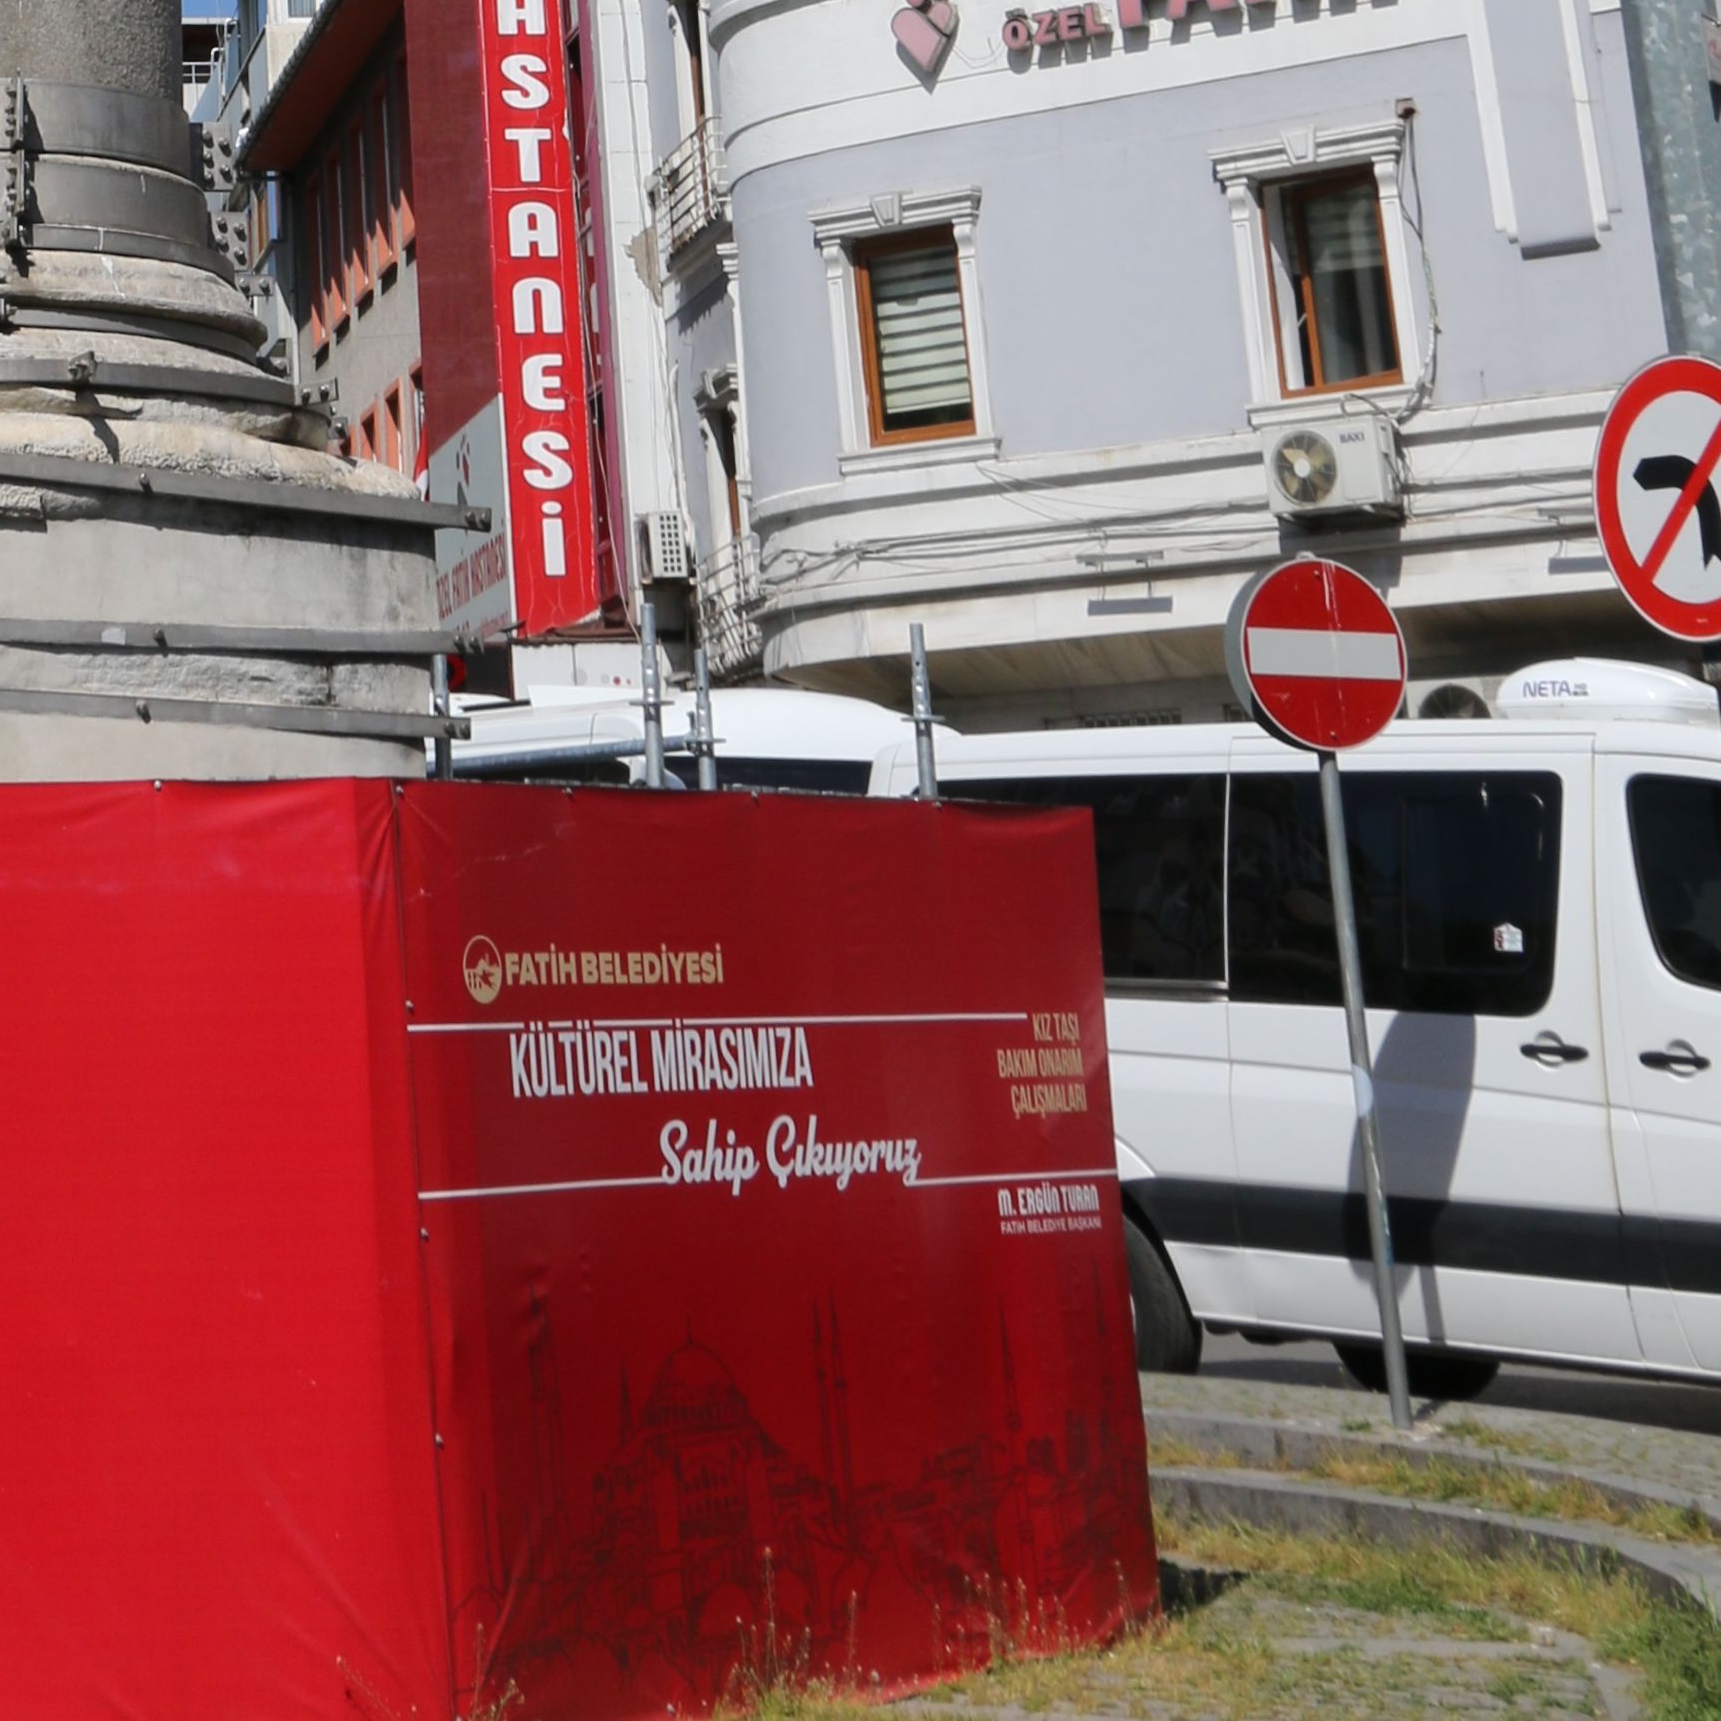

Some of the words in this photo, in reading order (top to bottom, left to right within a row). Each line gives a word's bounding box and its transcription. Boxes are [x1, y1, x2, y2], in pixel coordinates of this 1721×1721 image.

[1002, 1, 1111, 51] ÖZEL
[1522, 679, 1571, 698] NETA
[504, 942, 578, 986] FATİH
[580, 942, 724, 985] BELEDİYESİ
[1032, 1012, 1054, 1042] KIZ
[1054, 1012, 1080, 1045] TAŞI
[509, 1019, 649, 1098] KÜLTÜREL
[650, 1018, 814, 1093] MİRASIMIZA
[996, 1048, 1038, 1079] BAKIM
[1038, 1047, 1084, 1077] ONARIM
[1010, 1084, 1088, 1119] ÇALIŞMALARI
[659, 1118, 760, 1197] Sahip
[765, 1113, 922, 1192] Çıkıyoruz
[997, 1187, 1017, 1217] M.
[1017, 1182, 1061, 1217] ERGÜN
[1060, 1184, 1100, 1212] TURAN
